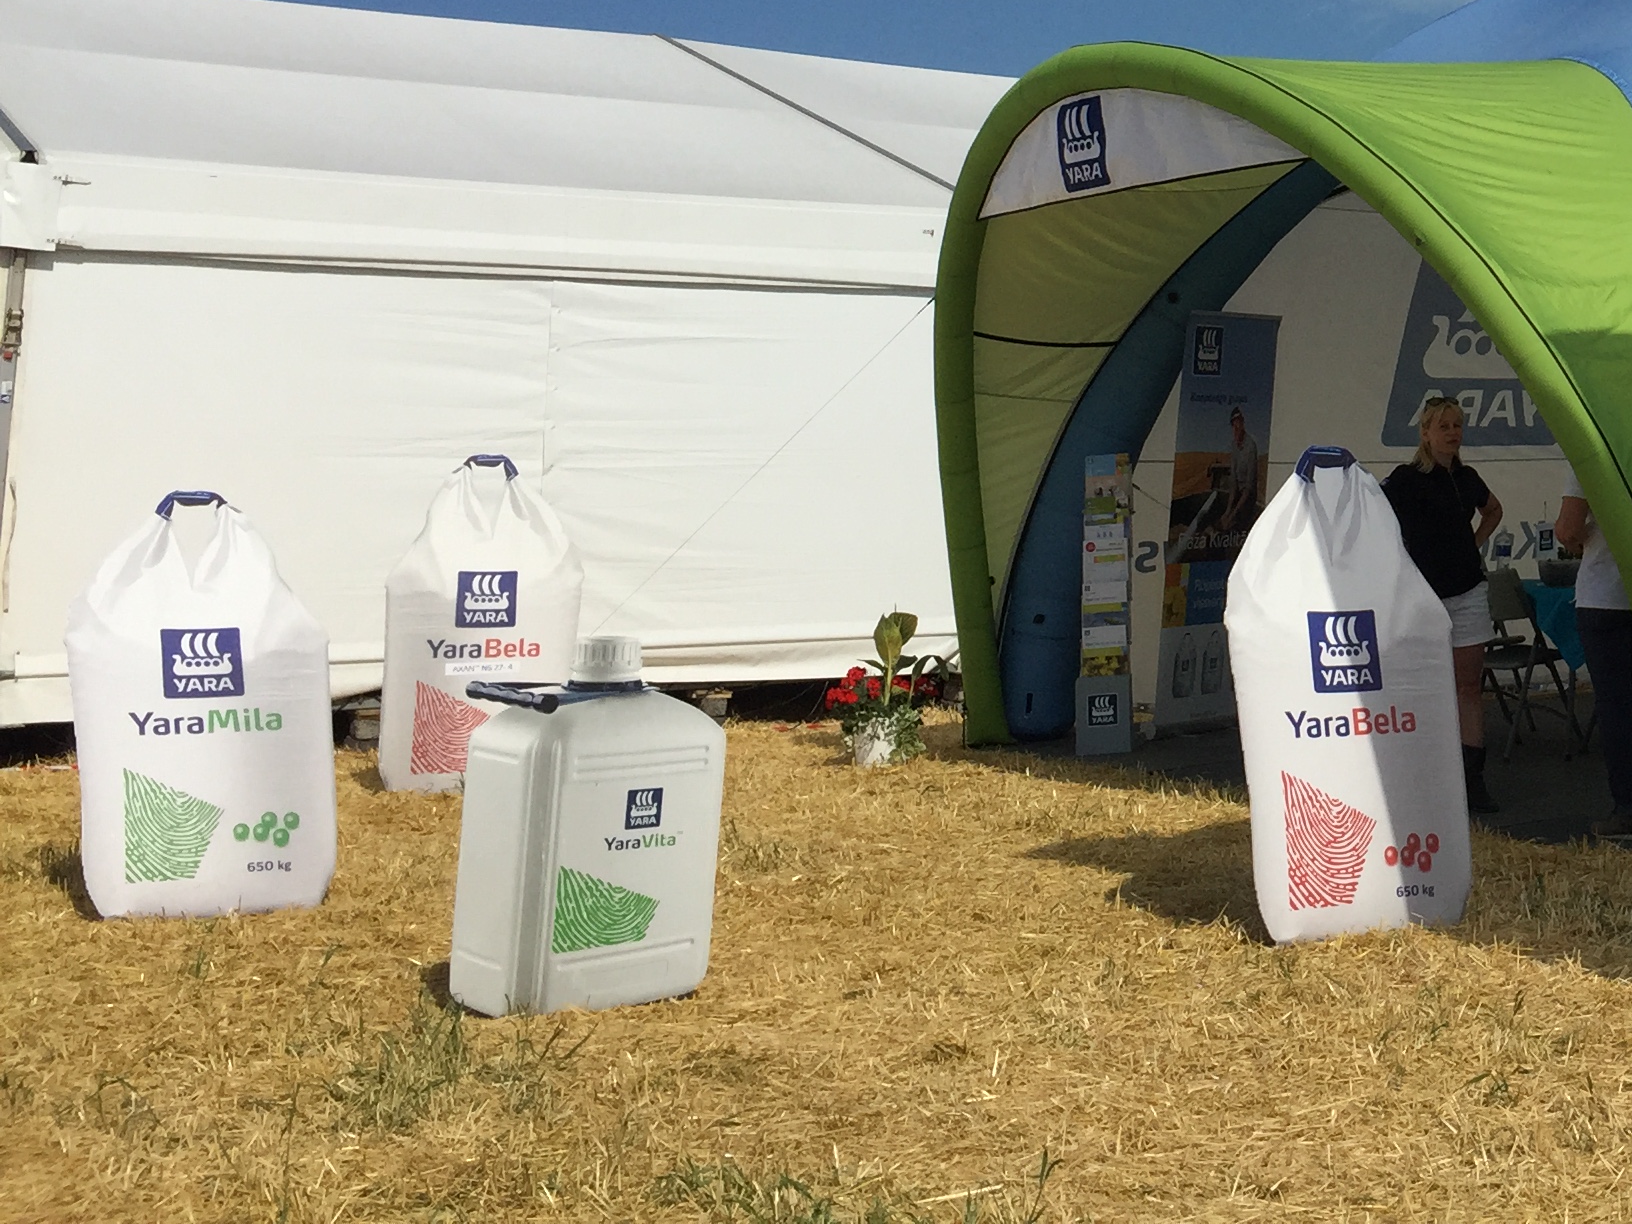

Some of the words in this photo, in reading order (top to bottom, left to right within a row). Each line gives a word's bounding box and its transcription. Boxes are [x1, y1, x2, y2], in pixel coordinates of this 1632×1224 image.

[1065, 162, 1103, 184] YARA
[463, 611, 509, 624] YARA
[427, 637, 541, 659] YaraBela
[173, 677, 235, 693] YARA
[1321, 668, 1374, 686] YARA
[128, 707, 283, 736] YaraMila
[1285, 705, 1417, 739] YaraBela
[630, 816, 657, 826] YARA
[247, 861, 274, 873] 650
[277, 860, 292, 873] kg
[1396, 884, 1419, 898] 650
[1422, 884, 1435, 897] kg
